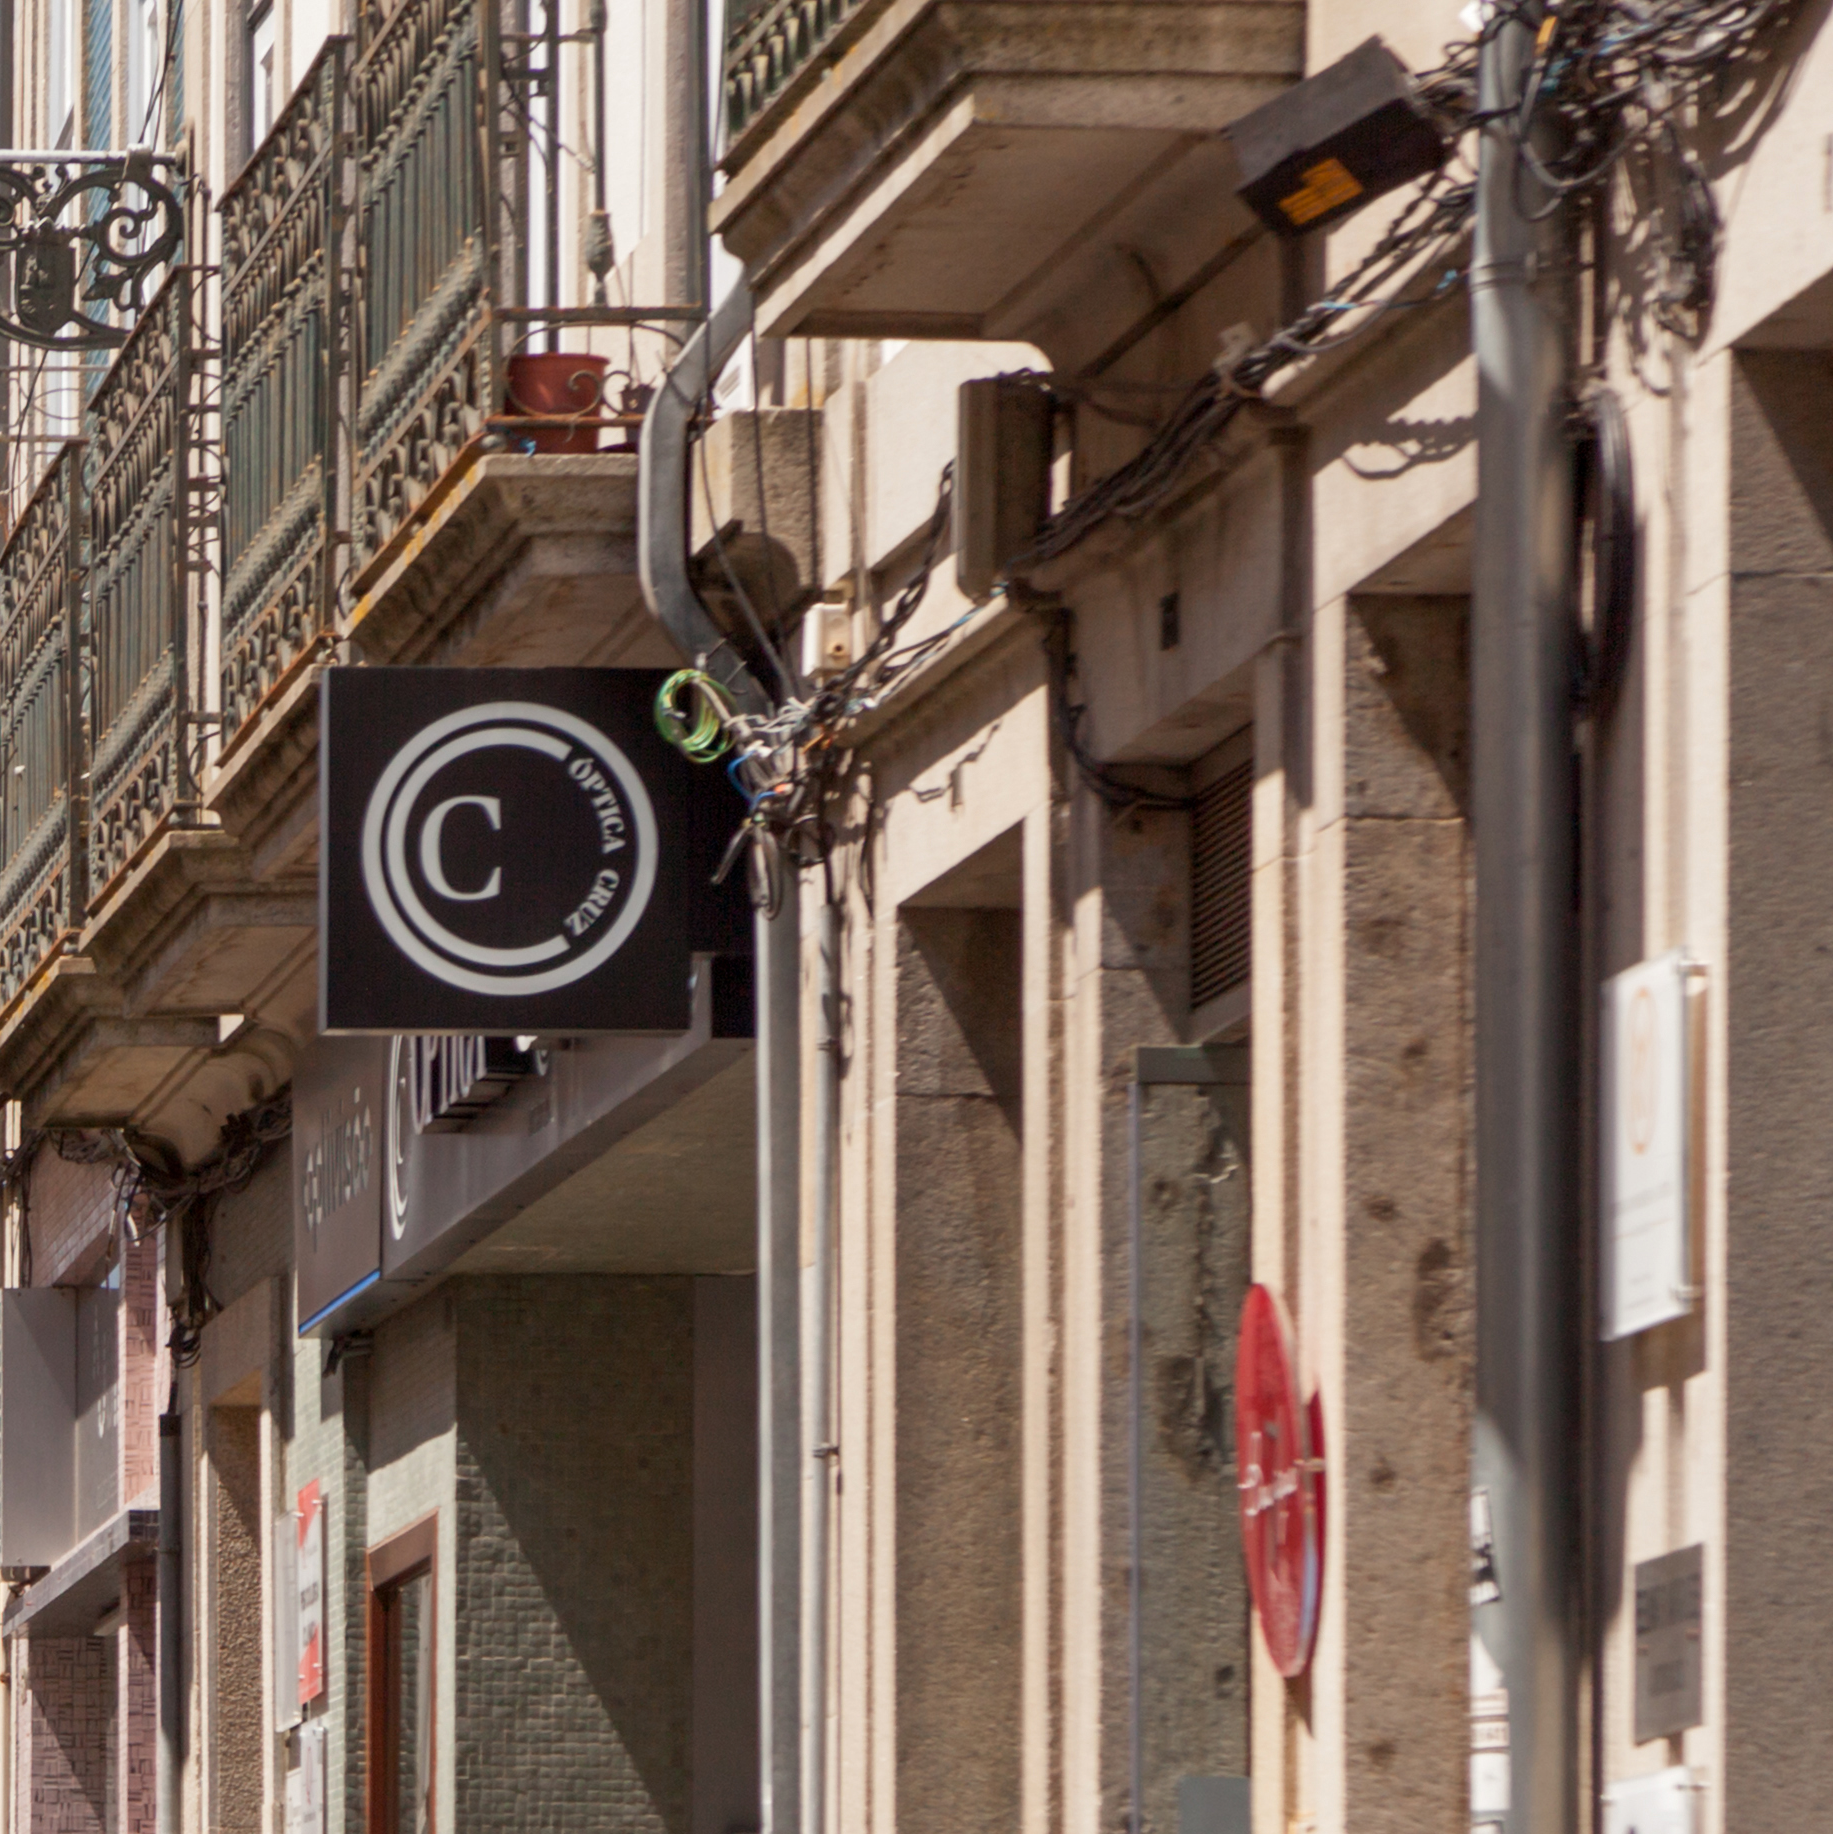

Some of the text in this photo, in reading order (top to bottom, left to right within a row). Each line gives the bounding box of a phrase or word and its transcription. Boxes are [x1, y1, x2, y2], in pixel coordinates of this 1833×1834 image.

[419, 794, 502, 902] C
[563, 757, 626, 937] ÓPTICA CRUZ
